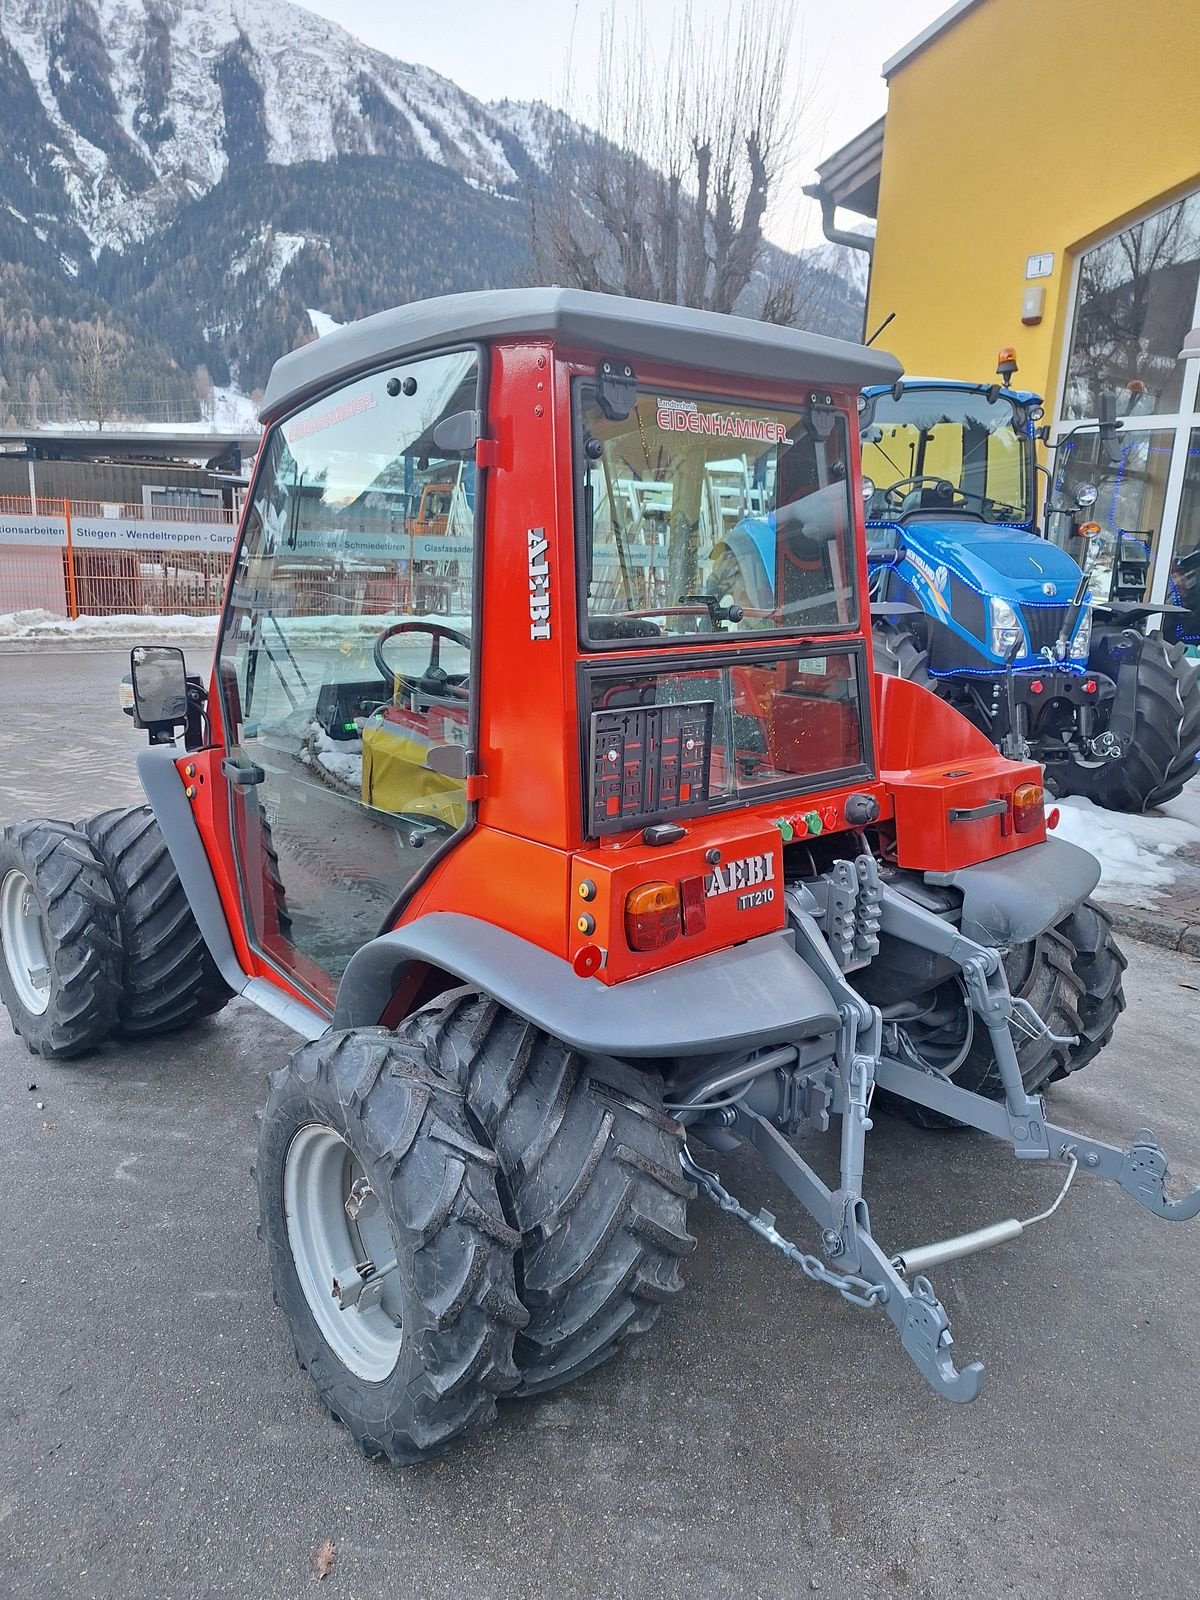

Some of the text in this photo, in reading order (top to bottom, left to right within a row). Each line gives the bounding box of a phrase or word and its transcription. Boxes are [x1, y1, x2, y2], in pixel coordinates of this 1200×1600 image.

[657, 398, 697, 411] Landtechnik
[657, 409, 787, 443] EIDENHAMMER
[77, 528, 116, 539] Stiegen
[126, 530, 201, 542] Wendeltreppen
[344, 541, 405, 551] Schmiedetüren
[527, 528, 551, 640] AEBI
[706, 852, 775, 897] AEBI
[740, 888, 774, 910] TT210
